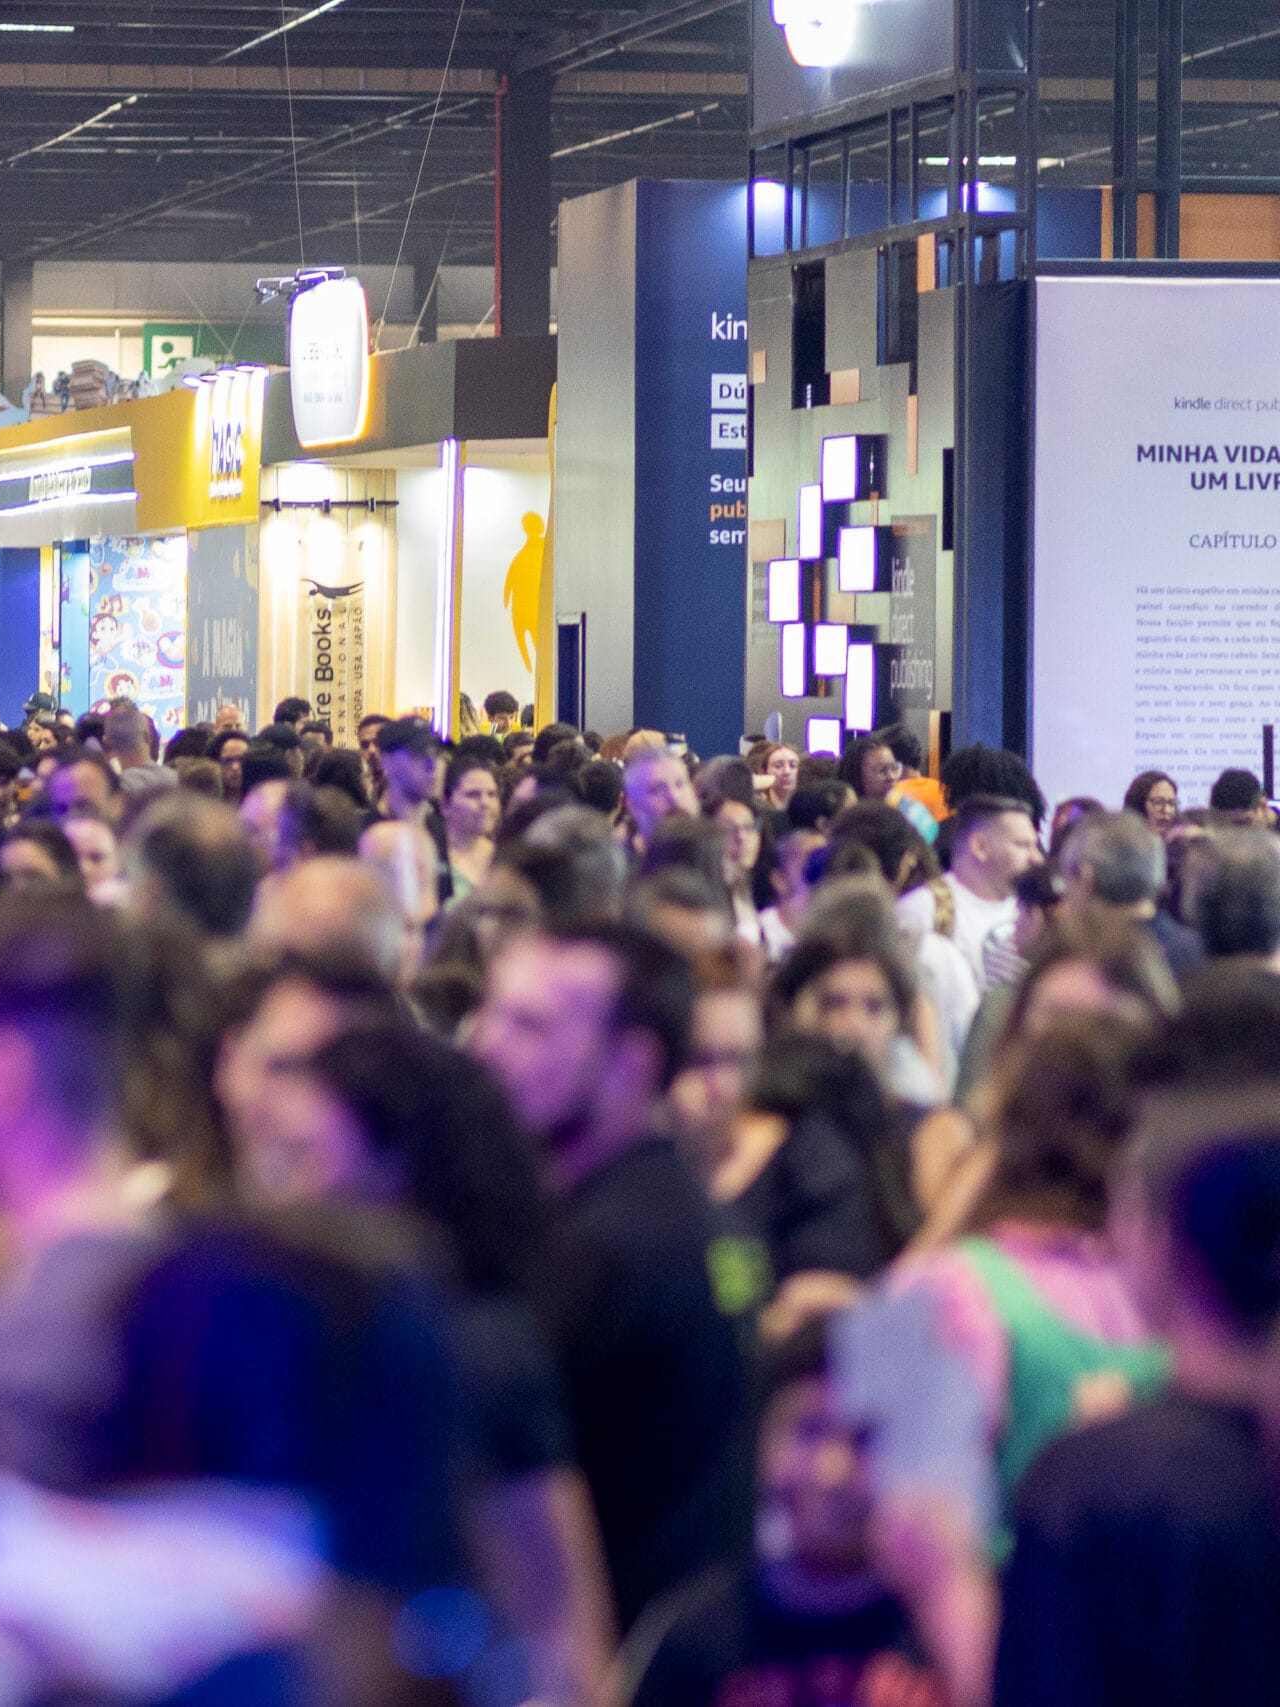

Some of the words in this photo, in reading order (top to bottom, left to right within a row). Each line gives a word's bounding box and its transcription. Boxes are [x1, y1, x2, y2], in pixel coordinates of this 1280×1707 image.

[1174, 396, 1211, 410] kindle
[1214, 396, 1252, 410] direct
[1136, 444, 1218, 463] MINHA
[1224, 444, 1280, 463] VIDA
[1190, 471, 1228, 490] UM
[1189, 530, 1277, 549] CAPÍTULO
[312, 608, 334, 682] Books
